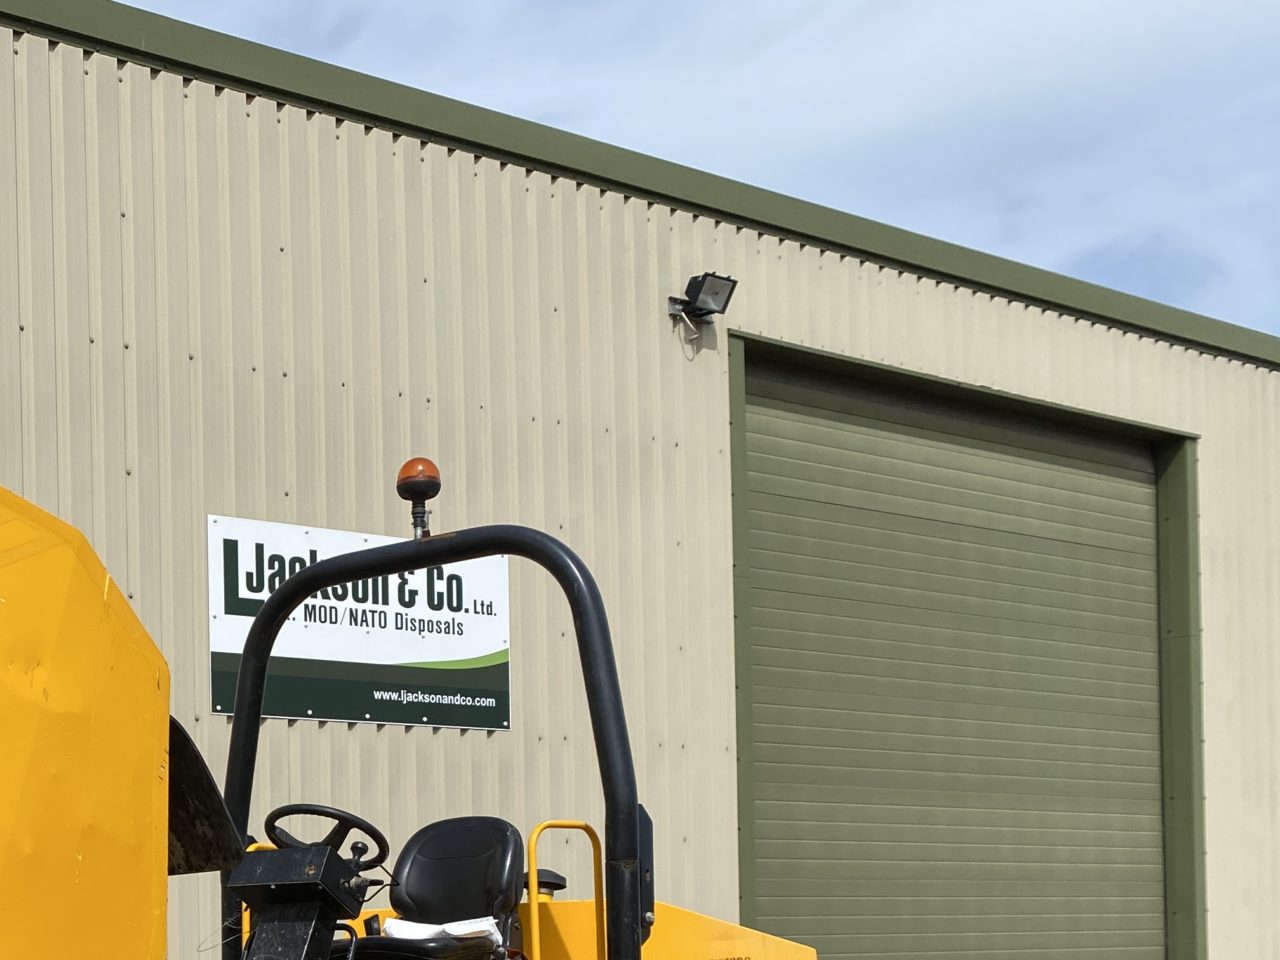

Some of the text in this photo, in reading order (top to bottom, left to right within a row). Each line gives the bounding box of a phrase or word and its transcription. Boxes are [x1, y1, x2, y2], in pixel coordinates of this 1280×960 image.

[426, 564, 469, 614] Co.
[473, 599, 497, 617] Ltd.
[303, 603, 464, 636] MOD/NATO Disposals
[373, 689, 496, 708] www.ljacksonandco.com
